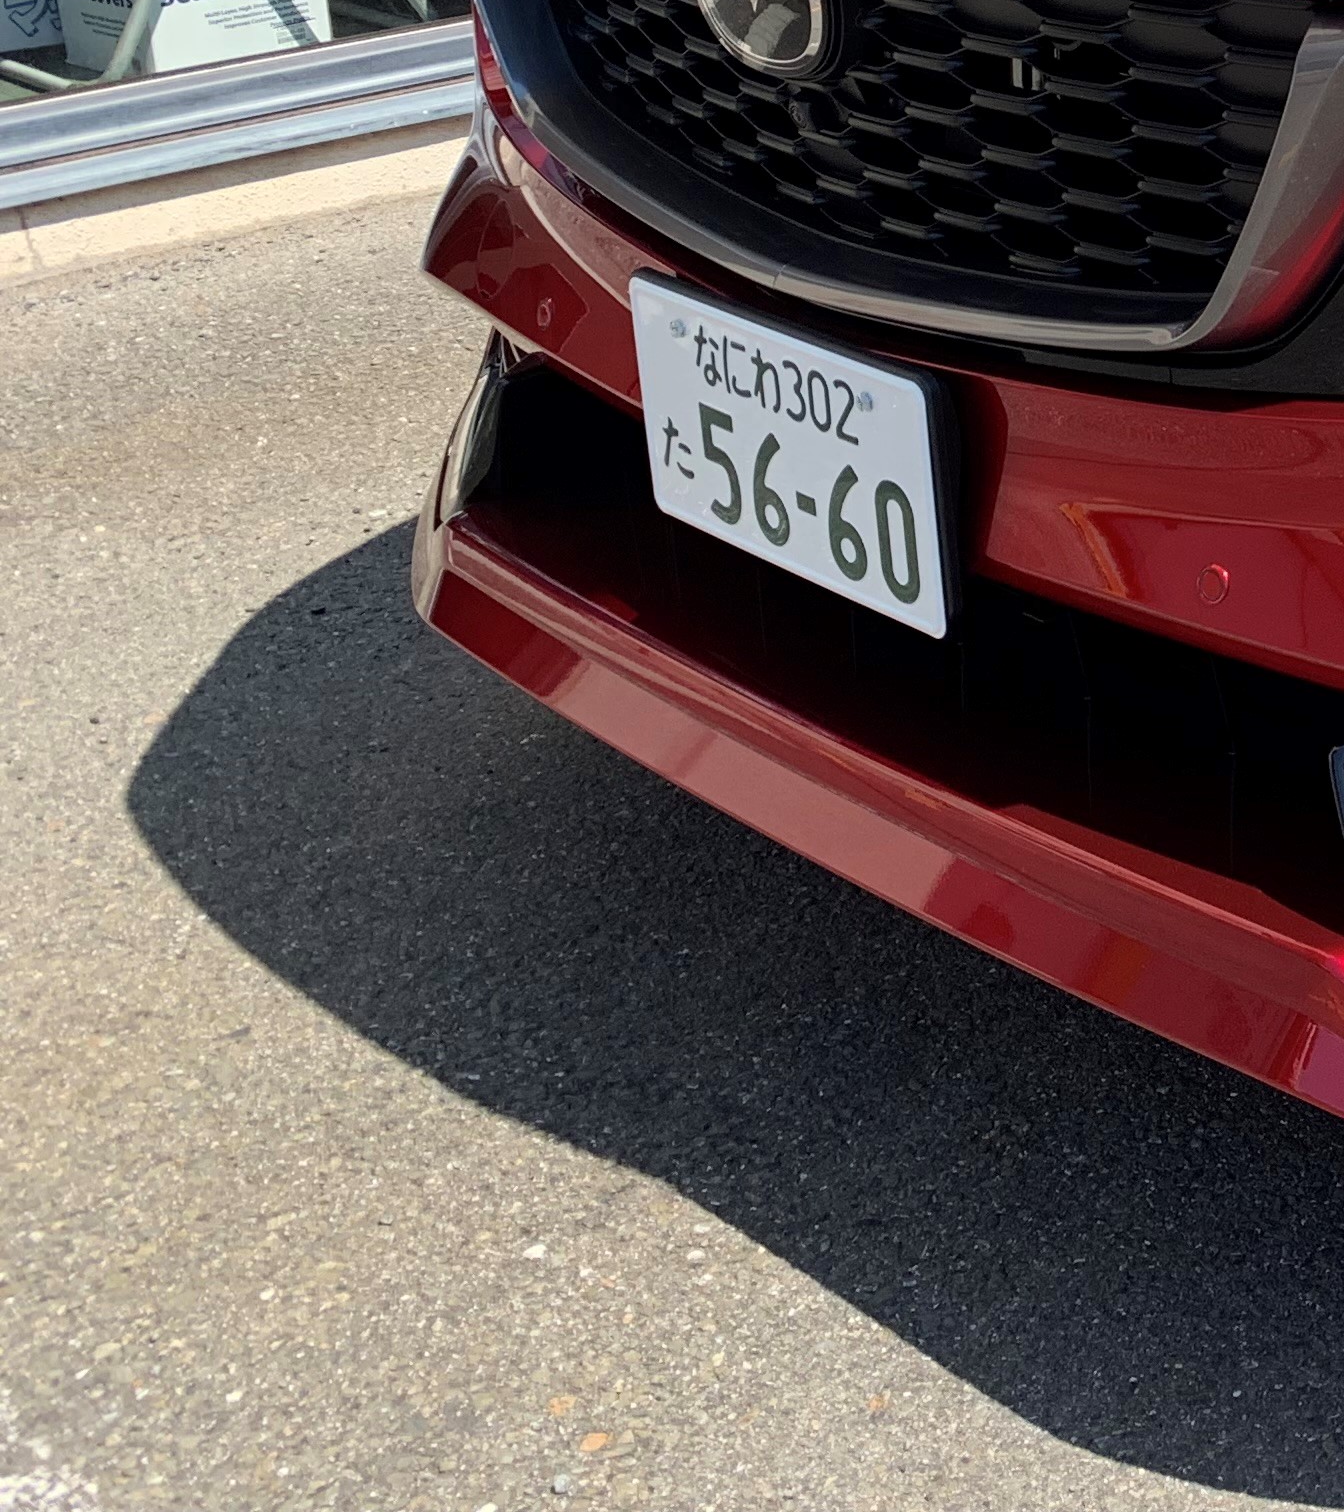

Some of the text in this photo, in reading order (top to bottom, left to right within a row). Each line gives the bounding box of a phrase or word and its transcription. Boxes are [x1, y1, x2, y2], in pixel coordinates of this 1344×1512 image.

[694, 325, 859, 445] なにわ302
[662, 402, 920, 604] た 56-60
